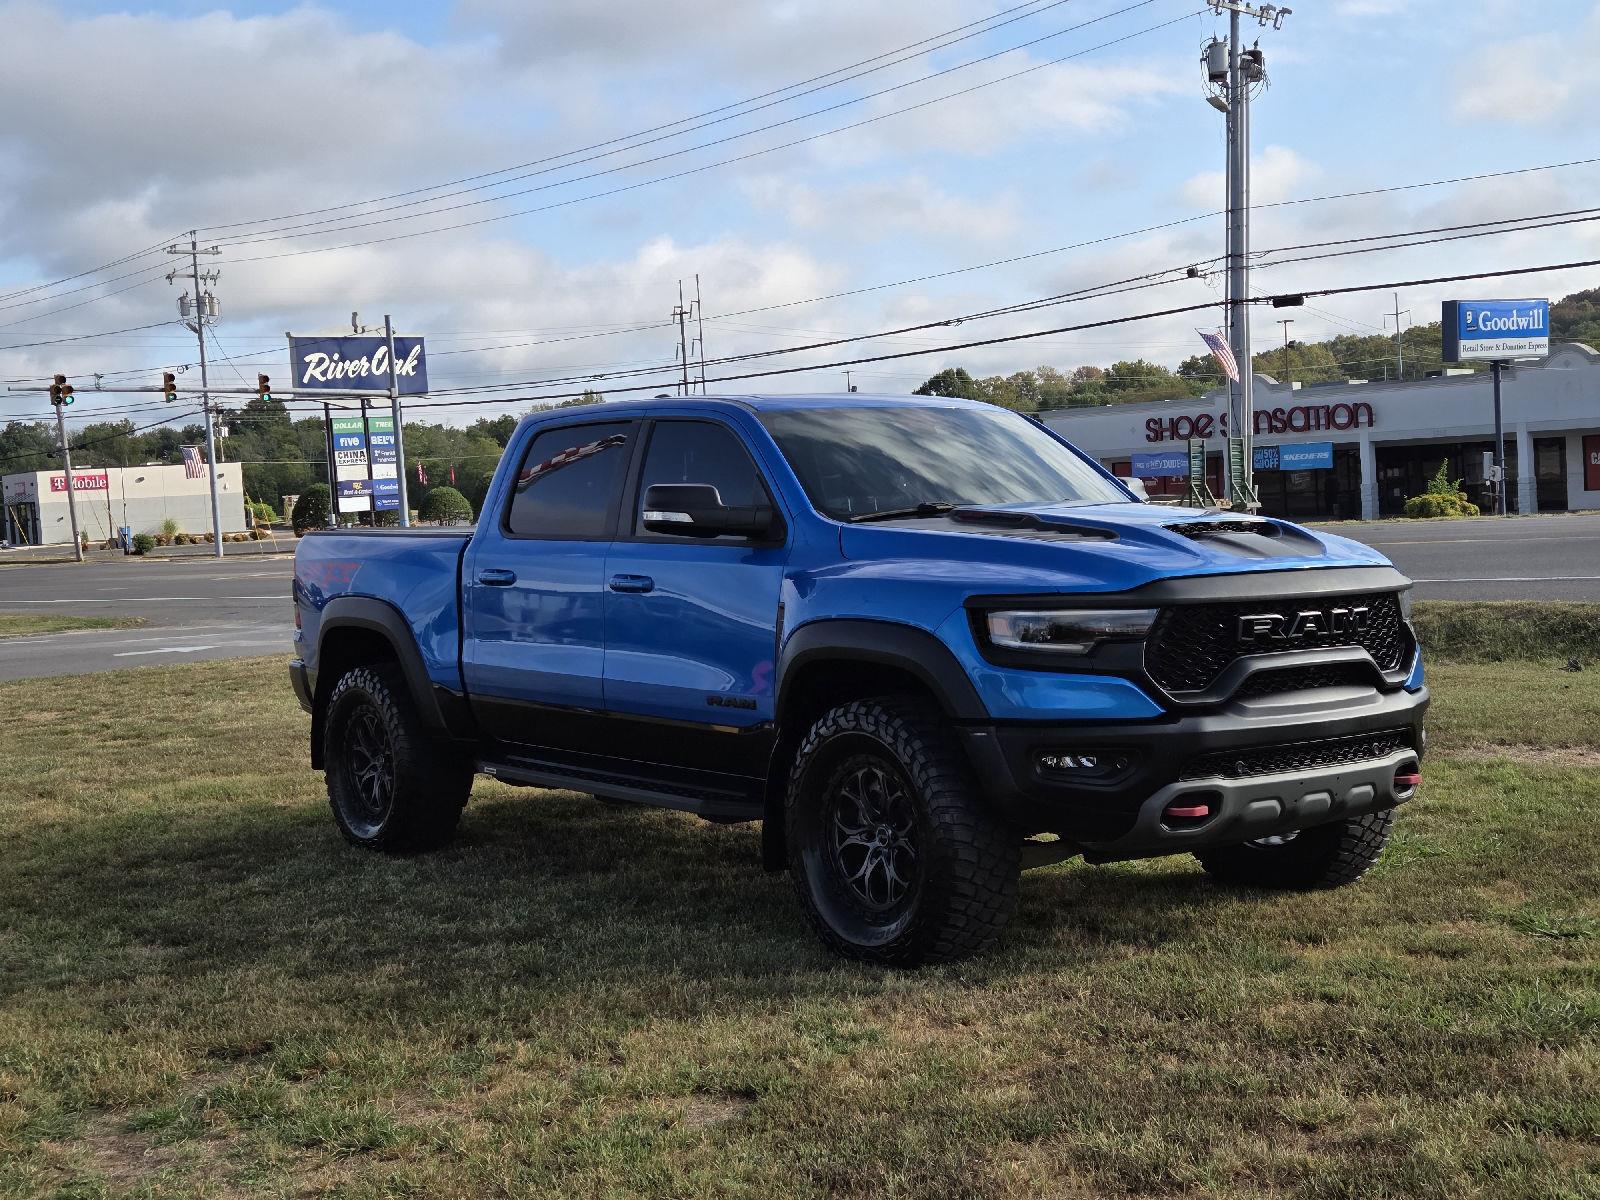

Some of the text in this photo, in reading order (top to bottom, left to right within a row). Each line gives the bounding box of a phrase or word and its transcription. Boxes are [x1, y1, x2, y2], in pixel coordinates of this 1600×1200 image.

[1478, 308, 1544, 331] Goodwill
[1462, 341, 1548, 353] Retail Store & Donation Express
[302, 352, 371, 384] River
[334, 422, 363, 430] DOLLAR
[339, 437, 360, 447] five
[337, 450, 366, 460] CHINA
[1263, 448, 1279, 459] 50%
[1283, 451, 1330, 461] SKECHERS
[1263, 458, 1279, 469] OFF
[1237, 606, 1369, 642] RAM
[706, 694, 758, 711] RAM
